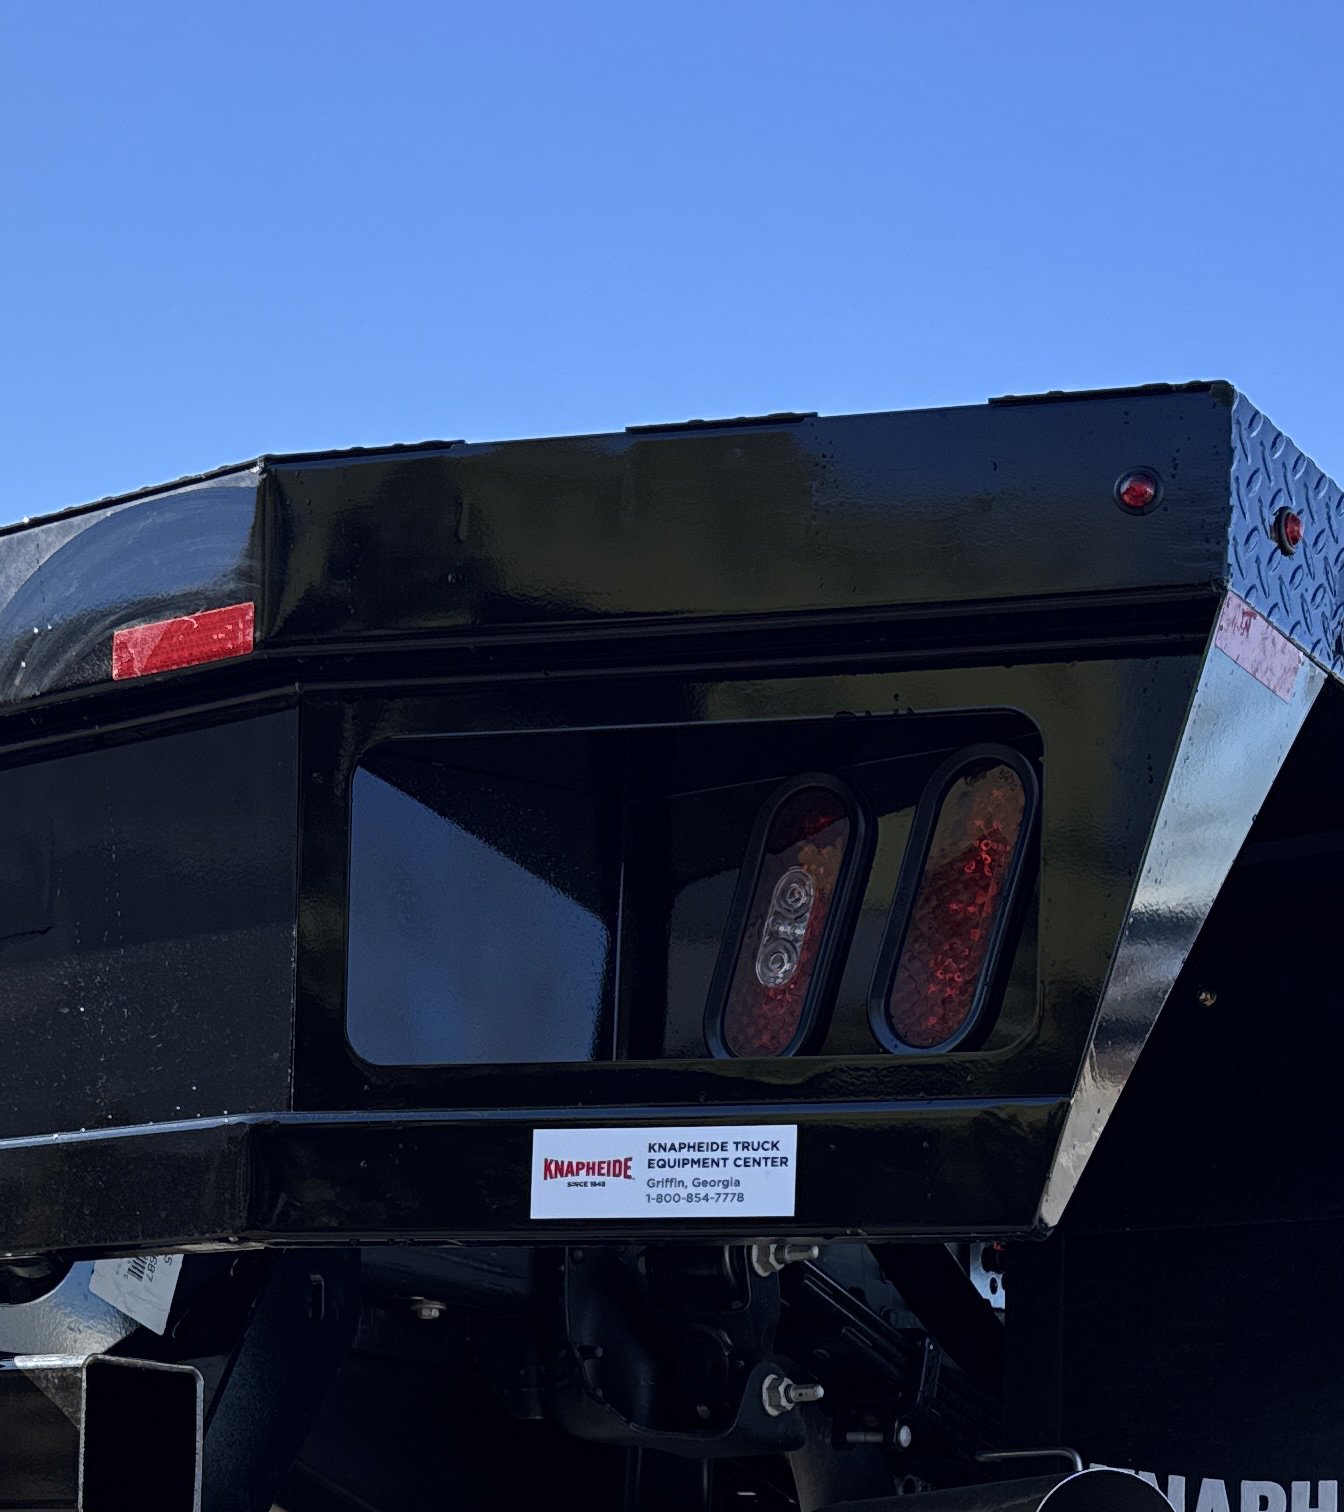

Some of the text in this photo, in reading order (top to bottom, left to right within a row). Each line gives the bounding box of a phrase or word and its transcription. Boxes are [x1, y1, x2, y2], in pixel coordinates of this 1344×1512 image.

[648, 1140, 780, 1153] KNAPHEIDE TRUCK
[544, 1157, 633, 1180] KNAPHEIDE
[647, 1157, 789, 1169] EQUIPMENT CENTER
[646, 1177, 741, 1189] Griffin, Georgia
[646, 1193, 745, 1204] 1-800-854-7778
